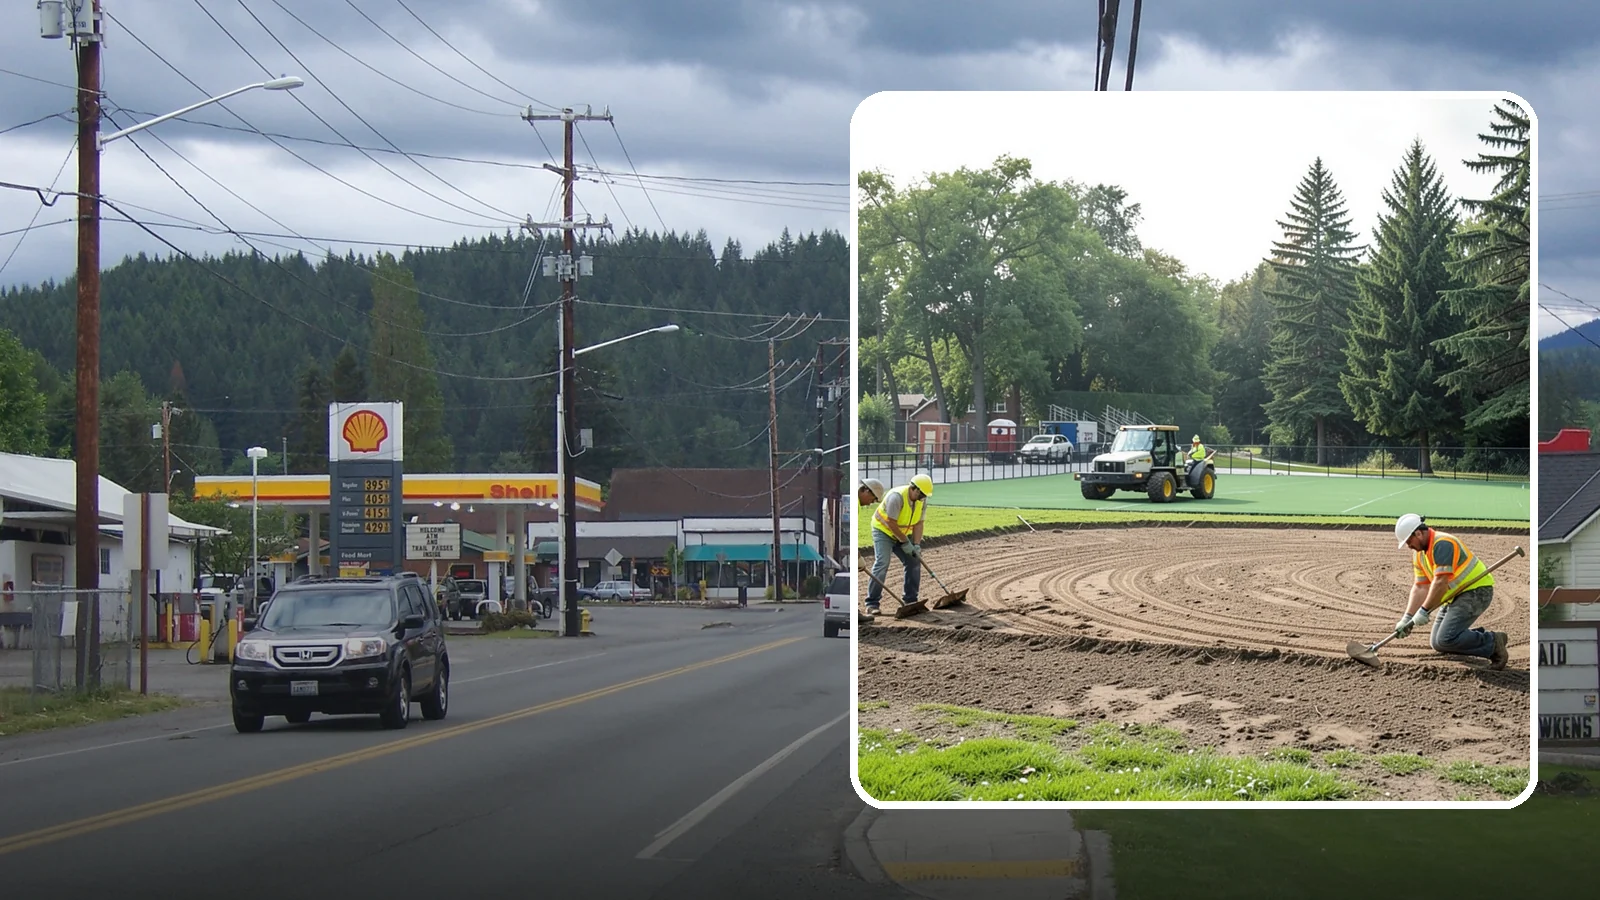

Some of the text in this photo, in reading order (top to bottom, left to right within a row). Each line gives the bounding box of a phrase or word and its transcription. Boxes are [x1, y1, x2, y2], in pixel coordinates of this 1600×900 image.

[366, 480, 383, 490] 395
[490, 484, 547, 499] Shell
[366, 494, 383, 504] 405
[366, 508, 383, 518] 415
[366, 522, 383, 532] 429
[1538, 643, 1567, 665] AID
